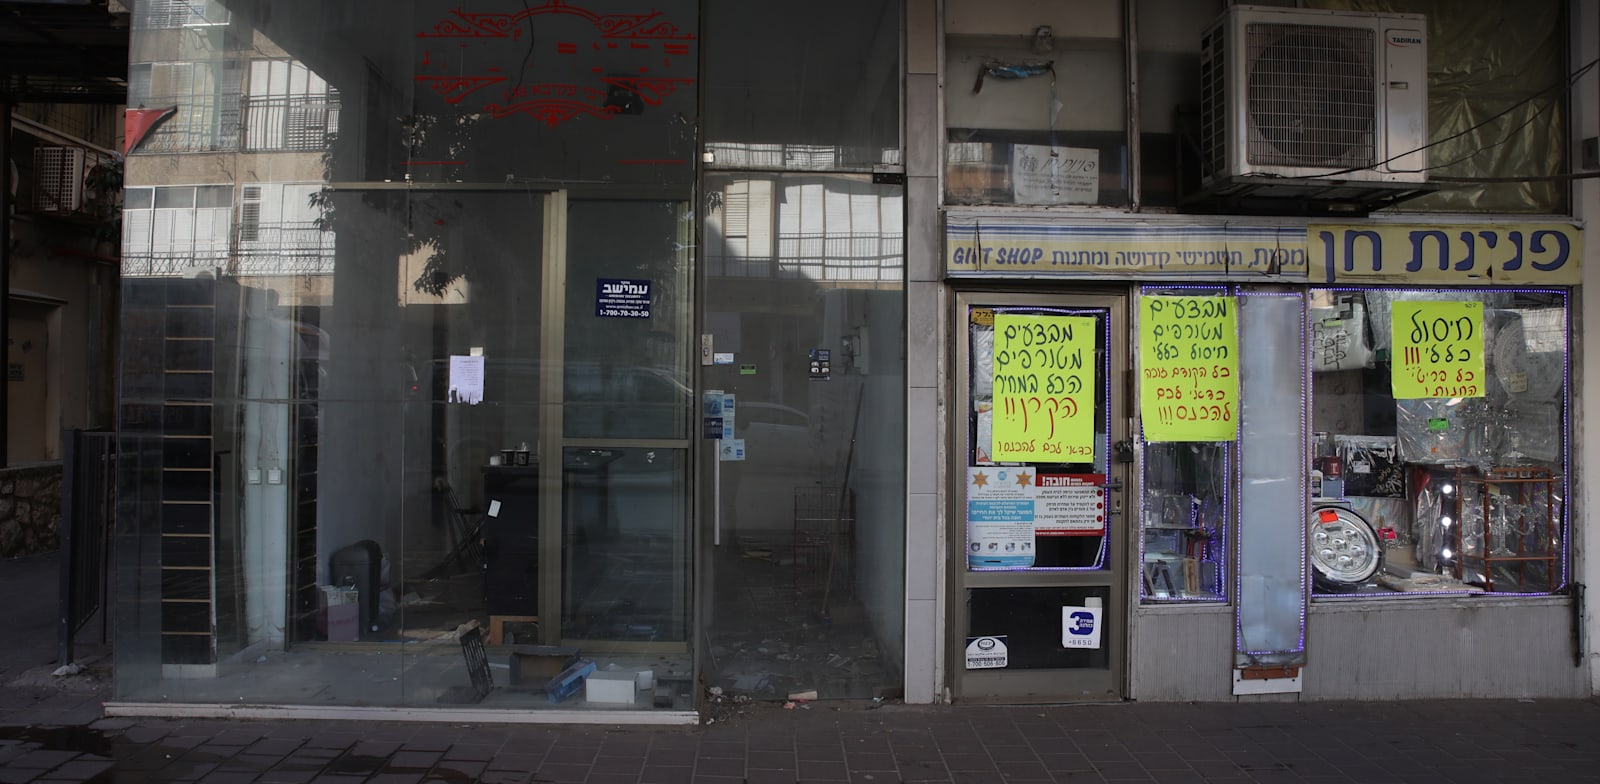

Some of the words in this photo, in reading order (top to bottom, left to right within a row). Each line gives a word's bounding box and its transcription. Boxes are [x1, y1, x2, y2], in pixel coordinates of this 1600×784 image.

[995, 247, 1044, 265] SHOP
[1051, 250, 1110, 266] ומתנות
[1115, 250, 1171, 270] קדושה
[1318, 230, 1383, 284] חן
[1405, 229, 1571, 273] פנינת
[602, 283, 649, 295] עמישב
[599, 309, 650, 318] 1-700-70-30-50
[1150, 298, 1227, 320] מבצעים
[1153, 321, 1223, 341] מטורפים
[1410, 309, 1473, 344] חיסול
[1004, 323, 1073, 349] מבצעים
[996, 345, 1082, 371] מטורפים
[1153, 342, 1179, 360] כללי
[1190, 343, 1228, 360] חיסול
[1144, 367, 1168, 379] זוכה
[1171, 367, 1207, 388] הקודם
[1212, 365, 1230, 379] כל
[1456, 368, 1474, 383] כל
[994, 374, 1039, 394] במחיר
[1046, 373, 1082, 395] הכל
[1157, 385, 1182, 400] לכם
[1042, 441, 1062, 455] לכם
[1041, 476, 1071, 487] חובה!
